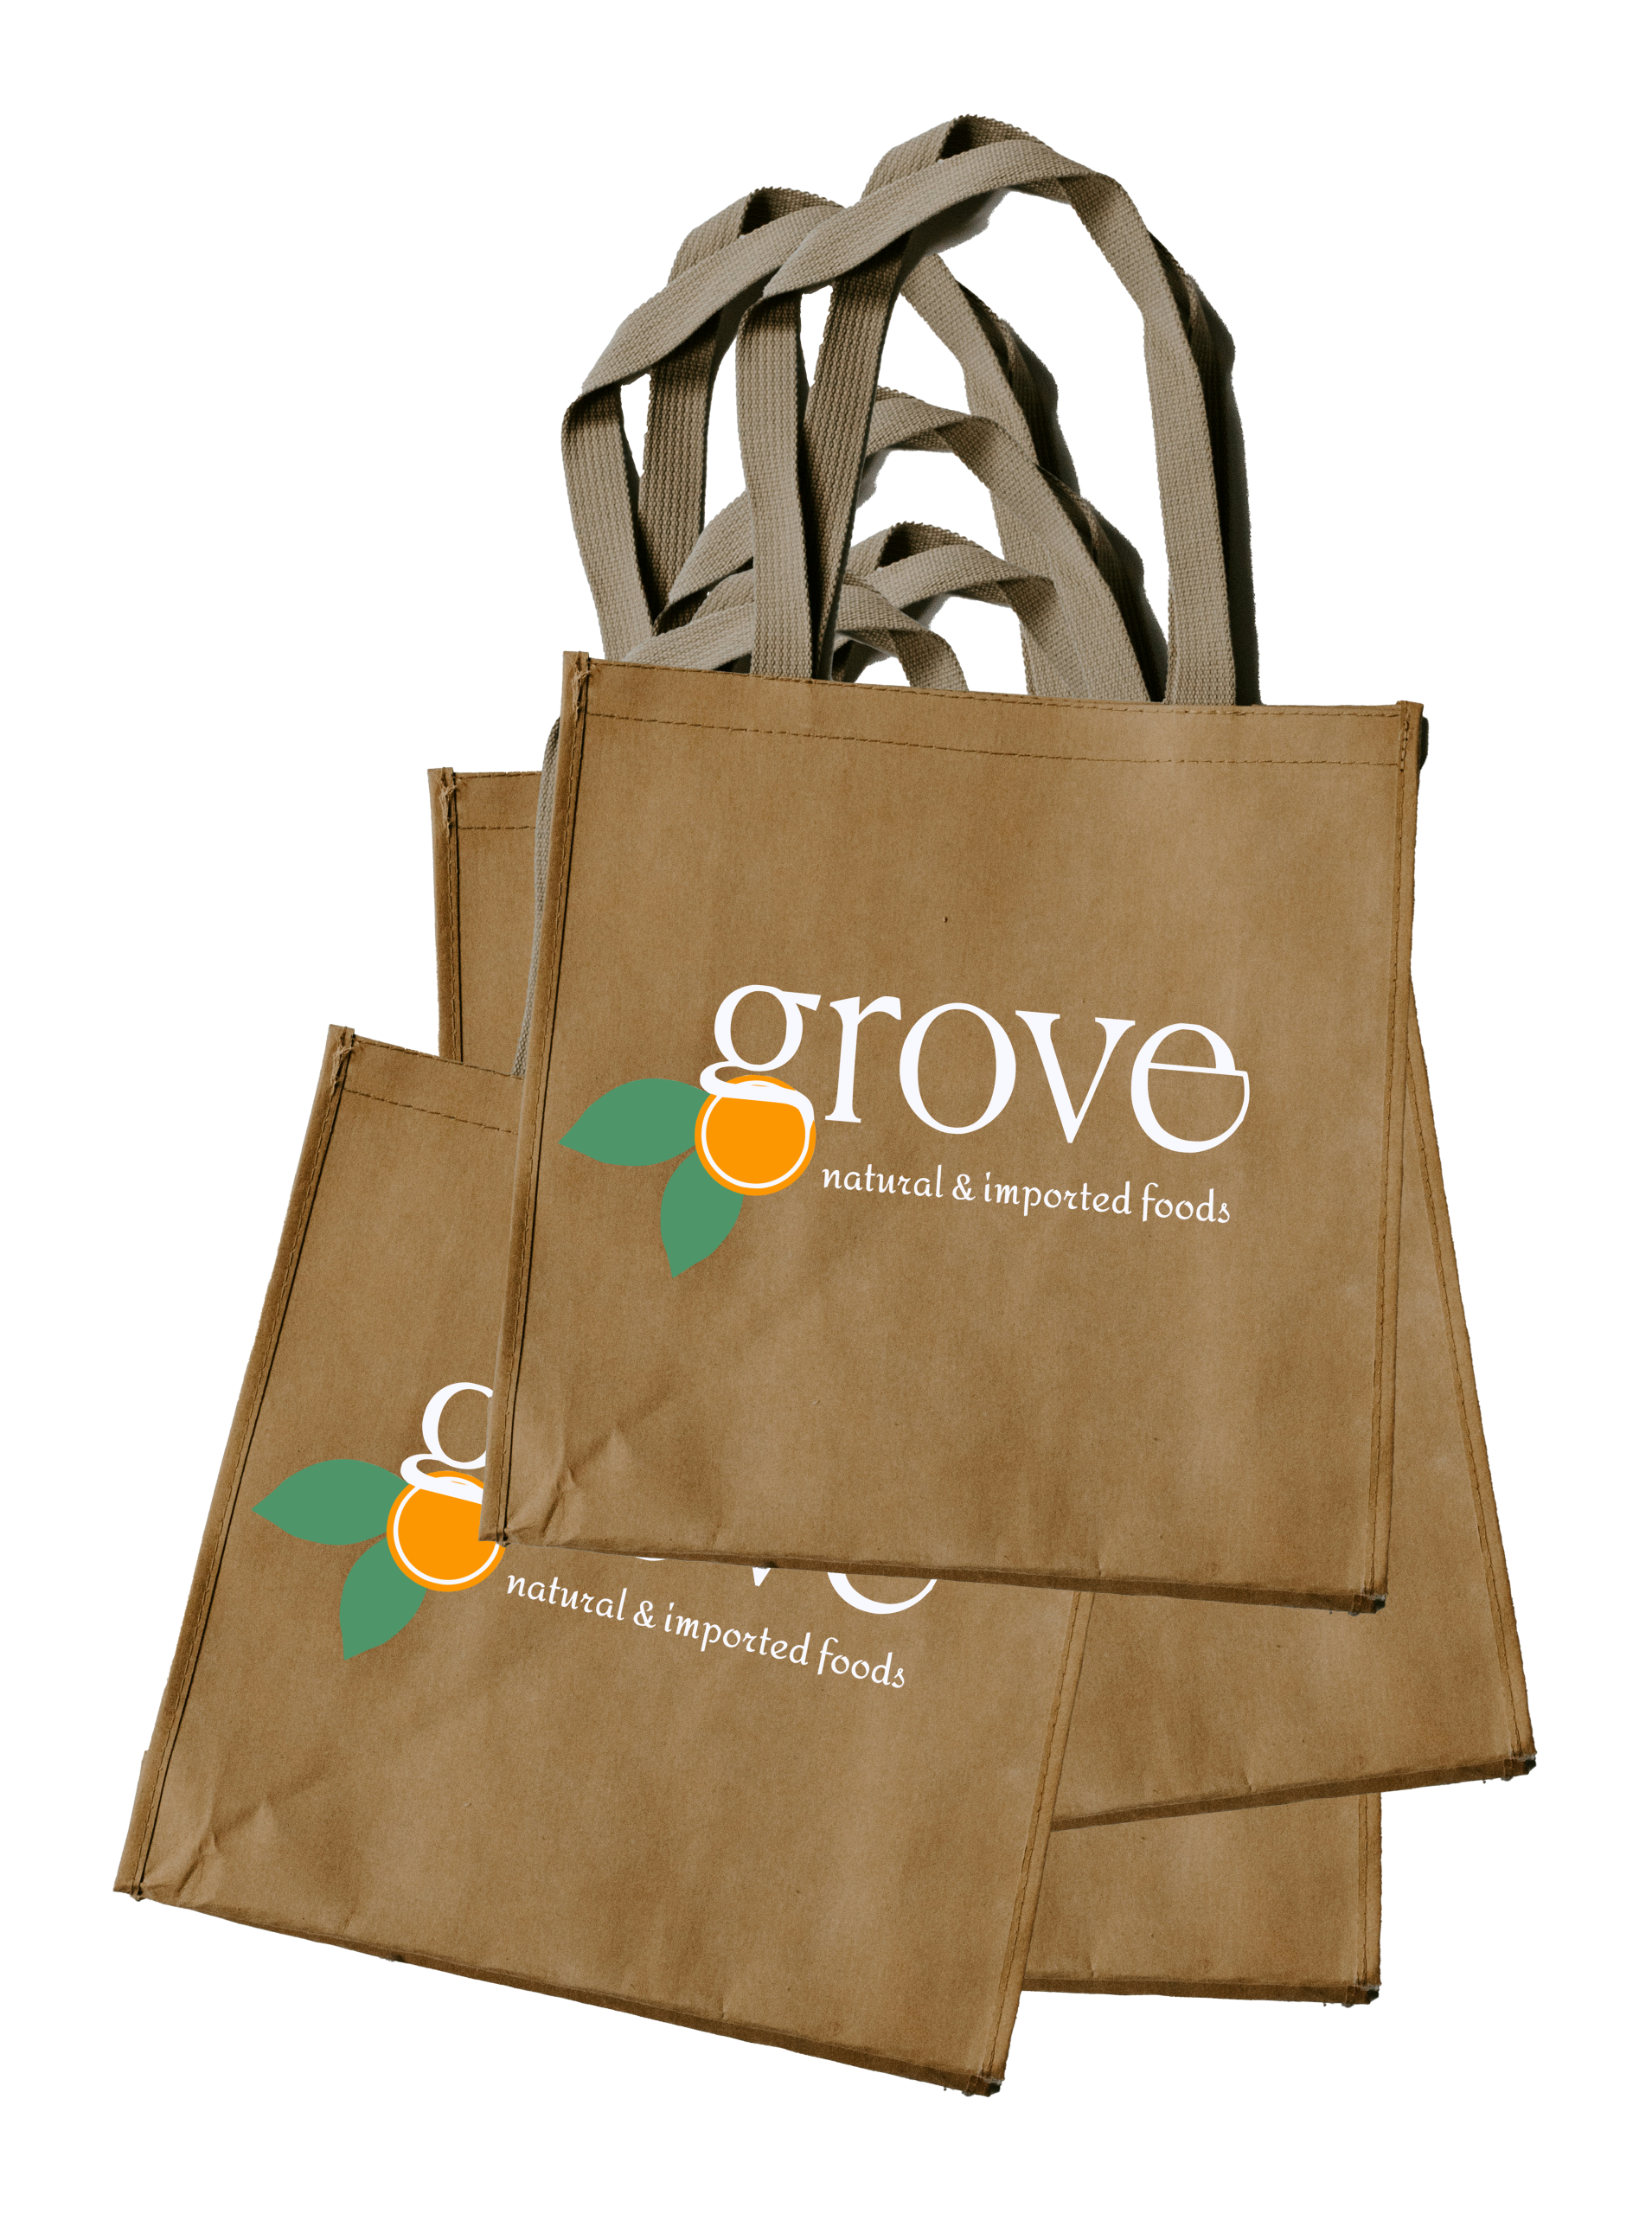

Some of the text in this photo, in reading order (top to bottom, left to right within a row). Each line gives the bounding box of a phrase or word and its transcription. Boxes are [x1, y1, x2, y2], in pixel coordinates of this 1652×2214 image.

[700, 983, 1251, 1190] grove
[821, 1163, 1231, 1224] natural & imported foods
[507, 1574, 906, 1689] natural & imported foods
